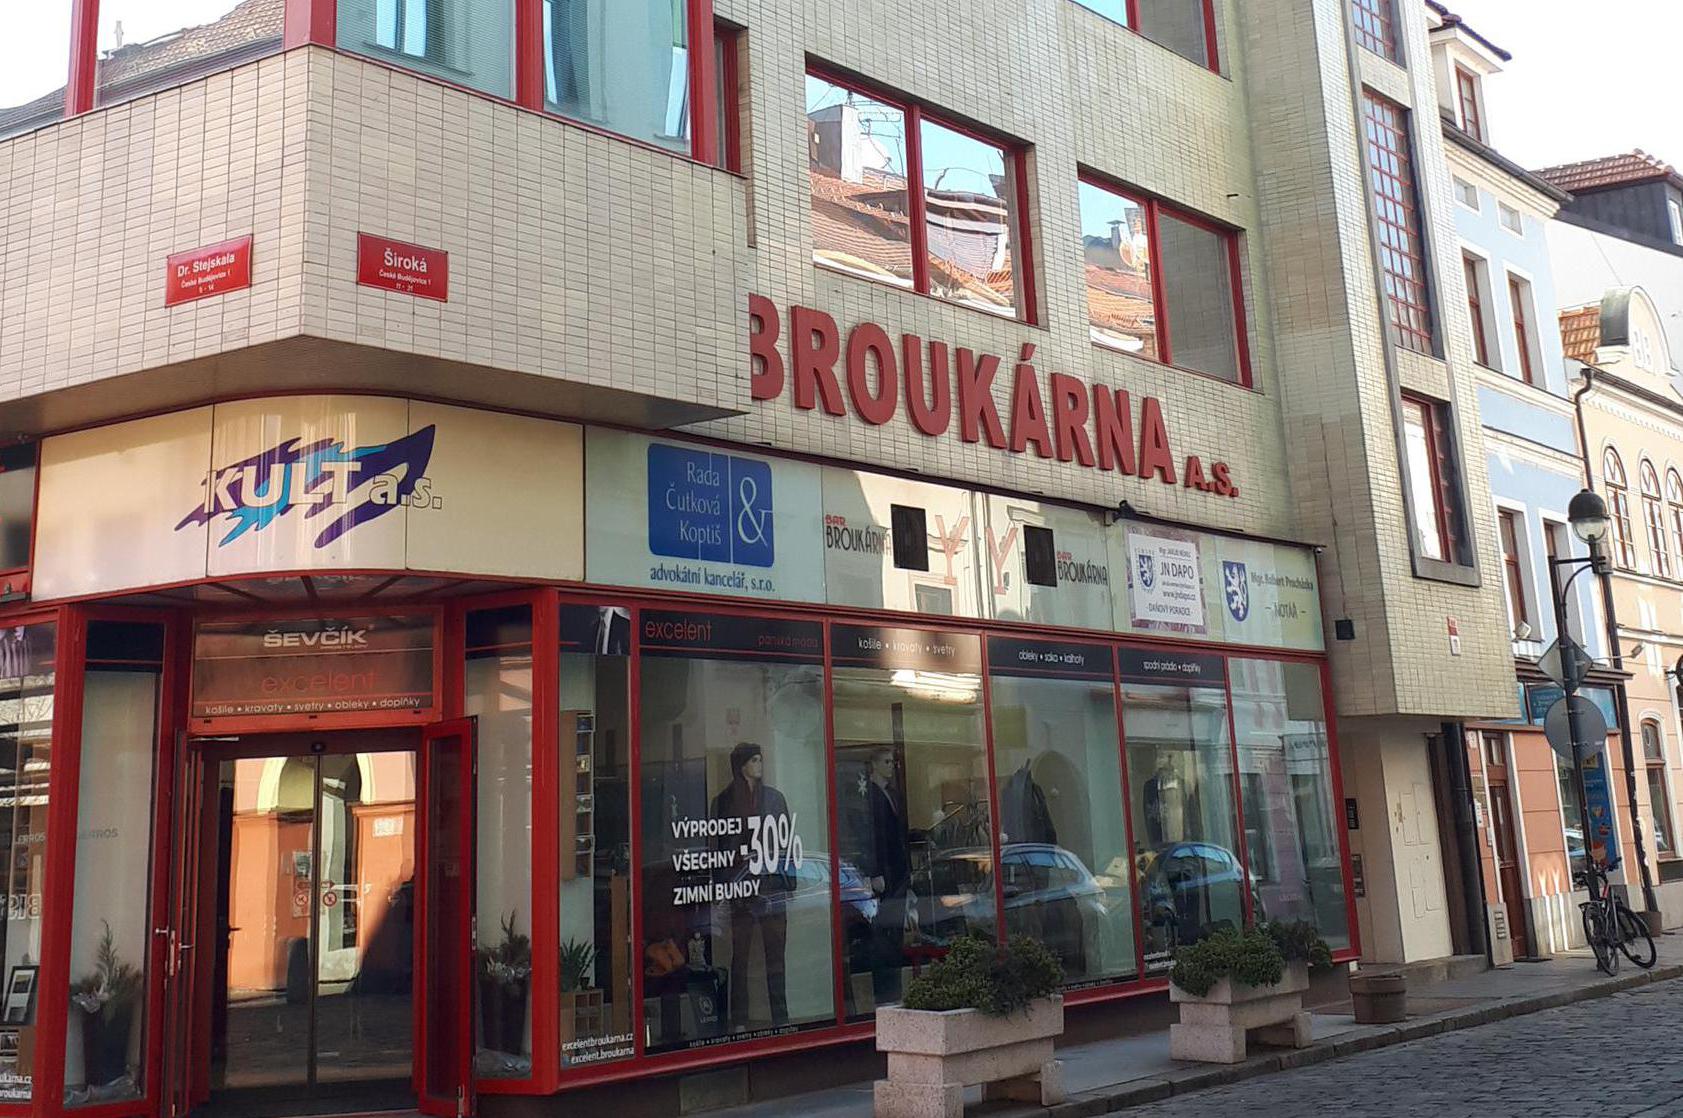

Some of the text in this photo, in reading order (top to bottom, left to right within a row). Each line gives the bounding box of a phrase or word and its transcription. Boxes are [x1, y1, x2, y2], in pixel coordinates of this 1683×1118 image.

[177, 252, 235, 278] Dr. Stejskala
[383, 247, 427, 273] Široká
[748, 292, 1239, 498] BROUKÁRNA A.S.
[687, 461, 720, 486] Rada
[203, 460, 443, 514] KULT a.s.
[666, 481, 721, 516] Čutková
[737, 476, 774, 546] &
[825, 514, 846, 526] BAR
[679, 520, 722, 546] Koptiš
[826, 524, 892, 557] BROUKÁRNA
[650, 563, 776, 593] advokátní kancelář, s.r.o.
[1057, 559, 1109, 587] BROUKÁRNA
[1171, 562, 1195, 580] DAPO
[263, 625, 369, 649] ŠEVČÍK
[645, 618, 713, 641] excelent
[857, 637, 956, 657] košile kravaty svetry
[261, 669, 380, 694] excelent
[205, 697, 421, 715] košile kravaty svetry obleky doplňky
[671, 816, 743, 839] VÝPRODEJ
[740, 812, 803, 876] -30%
[672, 849, 736, 872] VŠECHNY
[673, 879, 761, 906] ZIMNÍ BUNDY
